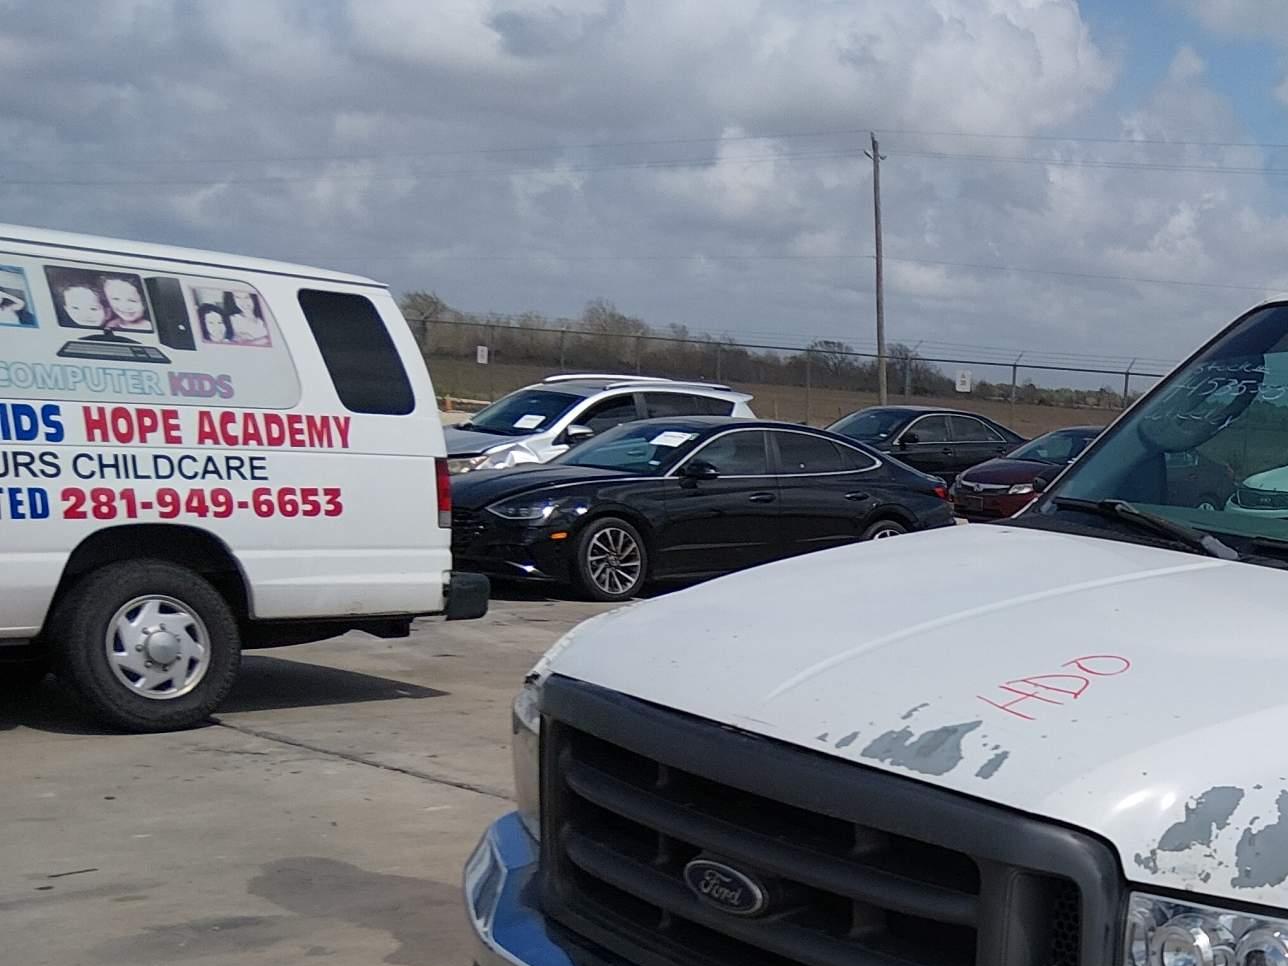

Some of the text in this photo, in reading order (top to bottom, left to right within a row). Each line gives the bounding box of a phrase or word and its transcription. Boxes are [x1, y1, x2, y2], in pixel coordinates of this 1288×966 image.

[168, 371, 234, 400] KIDS
[82, 406, 182, 445] HOPE
[197, 410, 351, 449] ACADEMY
[72, 453, 269, 480] CHILDCARE
[0, 486, 343, 520] ED 281-949-6653
[700, 868, 743, 905] Ford
